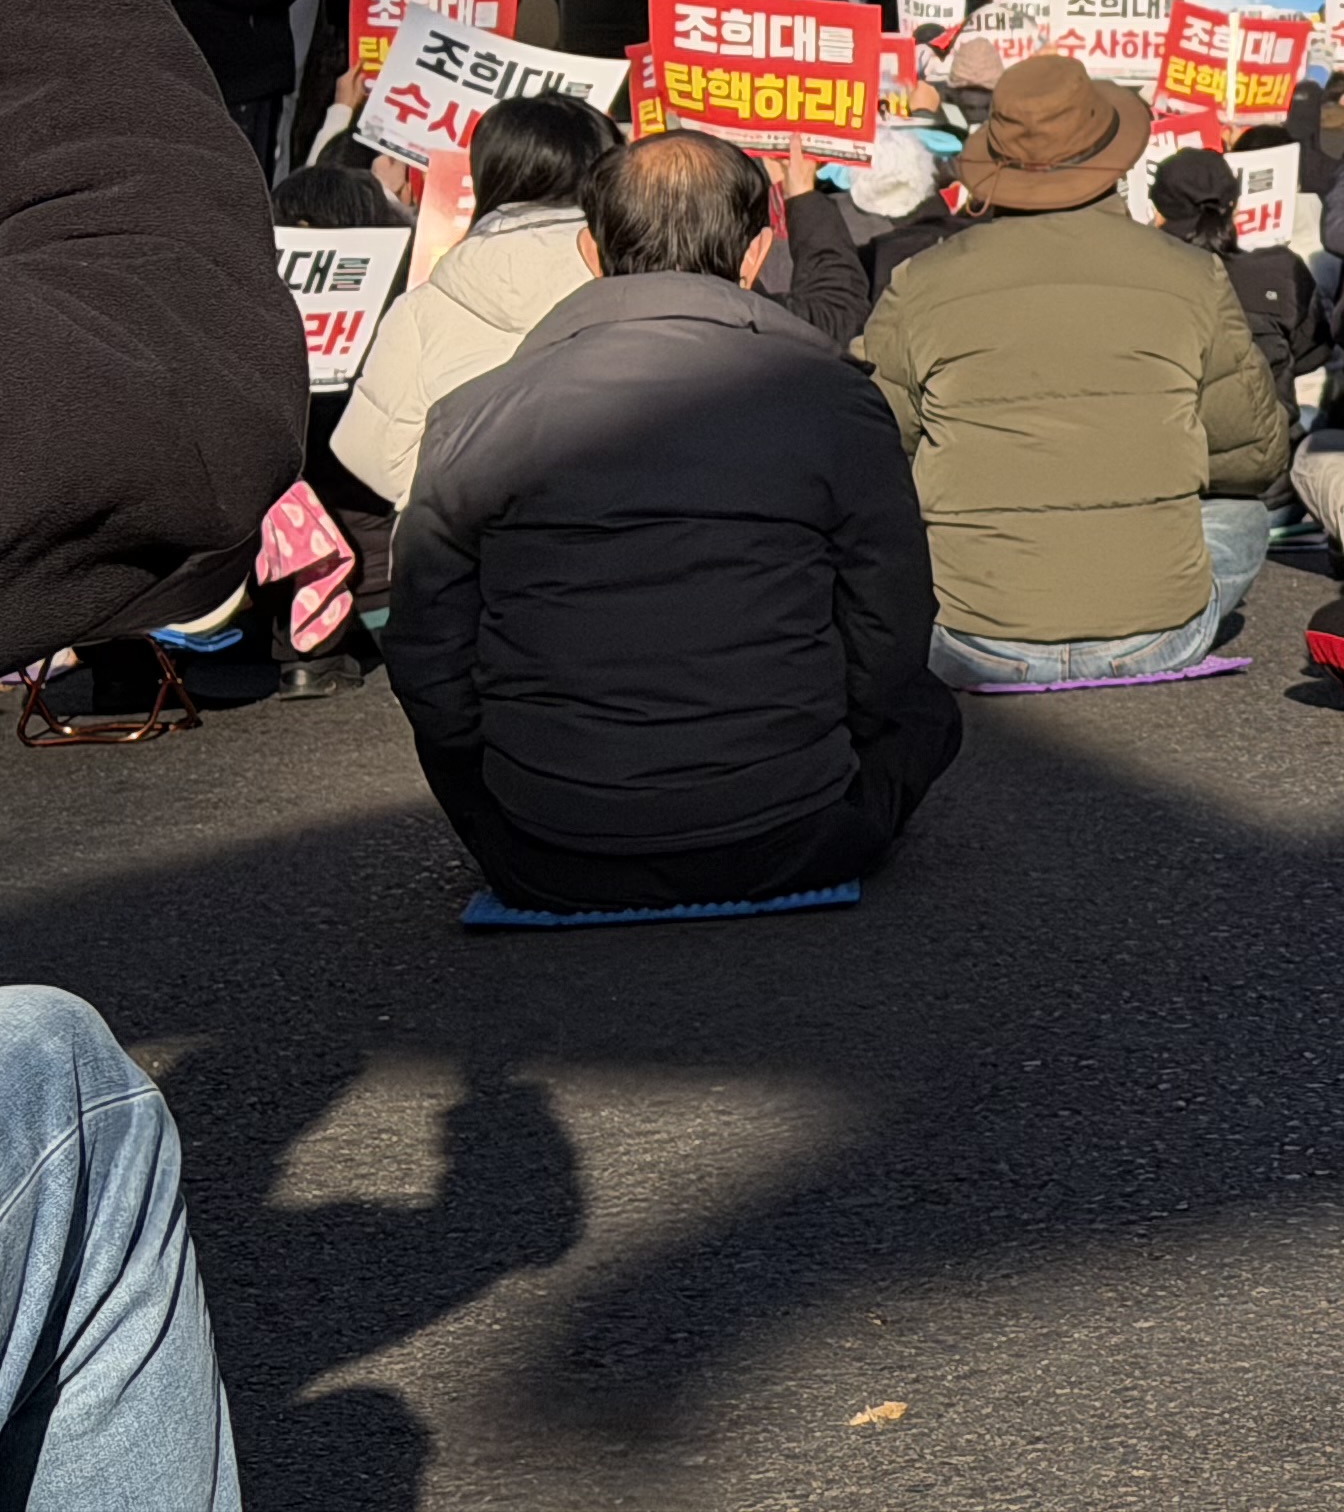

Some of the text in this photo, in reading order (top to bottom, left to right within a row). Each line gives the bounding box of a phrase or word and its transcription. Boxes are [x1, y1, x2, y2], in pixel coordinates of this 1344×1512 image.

[673, 3, 854, 64] 조희대를
[384, 83, 483, 149] 수사
[664, 61, 865, 129] 탄핵하라!
[277, 249, 371, 294] 대를
